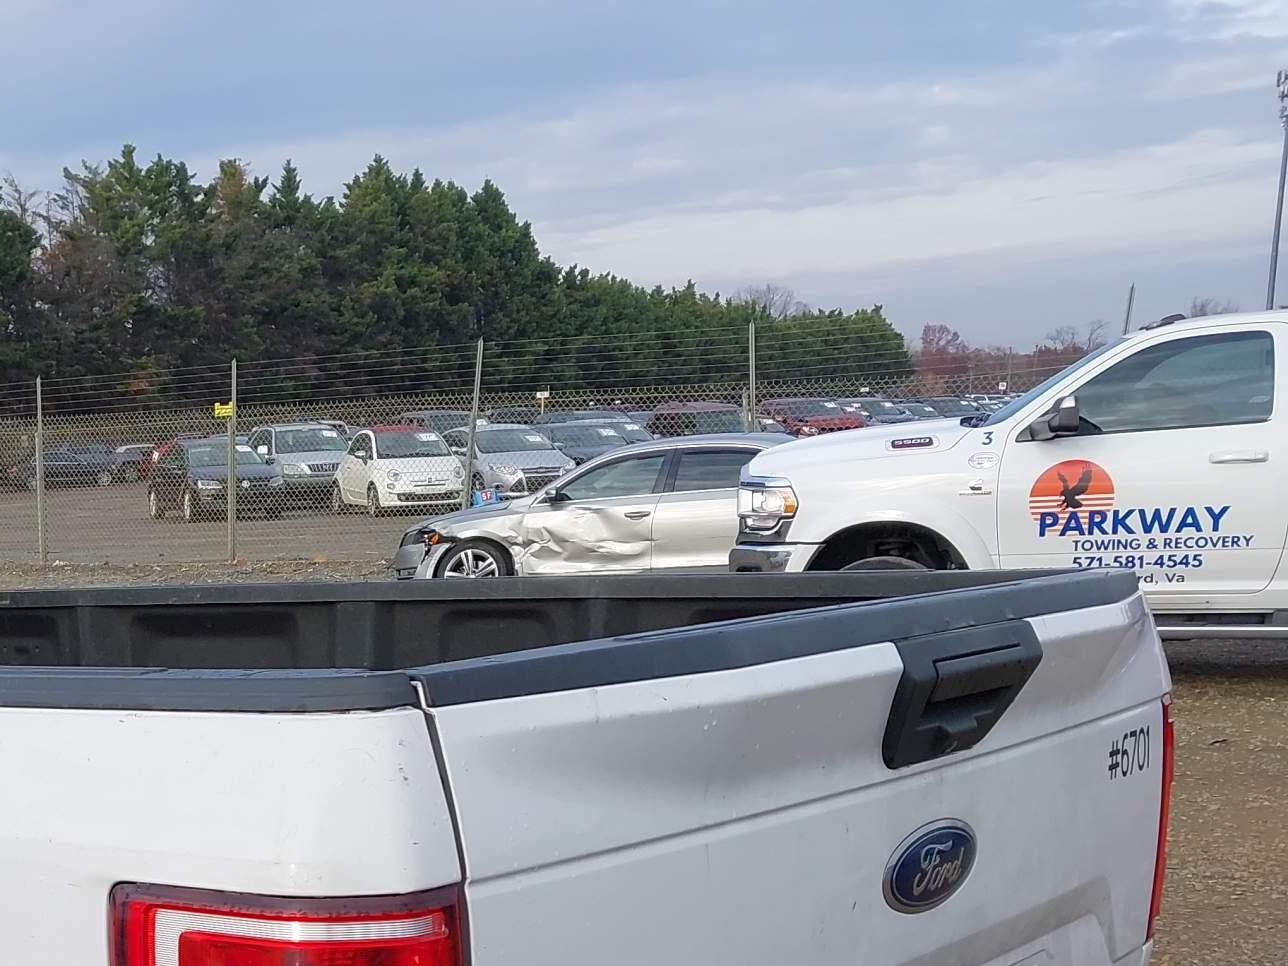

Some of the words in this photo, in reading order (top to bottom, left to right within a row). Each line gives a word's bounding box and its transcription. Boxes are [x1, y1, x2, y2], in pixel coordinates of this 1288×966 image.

[981, 431, 994, 446] 3
[1038, 505, 1232, 537] PARKWAY
[1072, 537, 1142, 552] TOWING
[1146, 536, 1158, 550] &
[1163, 535, 1255, 549] RECOVERY
[1072, 554, 1203, 569] 571-581-4545
[1165, 573, 1186, 584] Va
[1108, 724, 1150, 781] #6701
[912, 840, 965, 896] Ford
